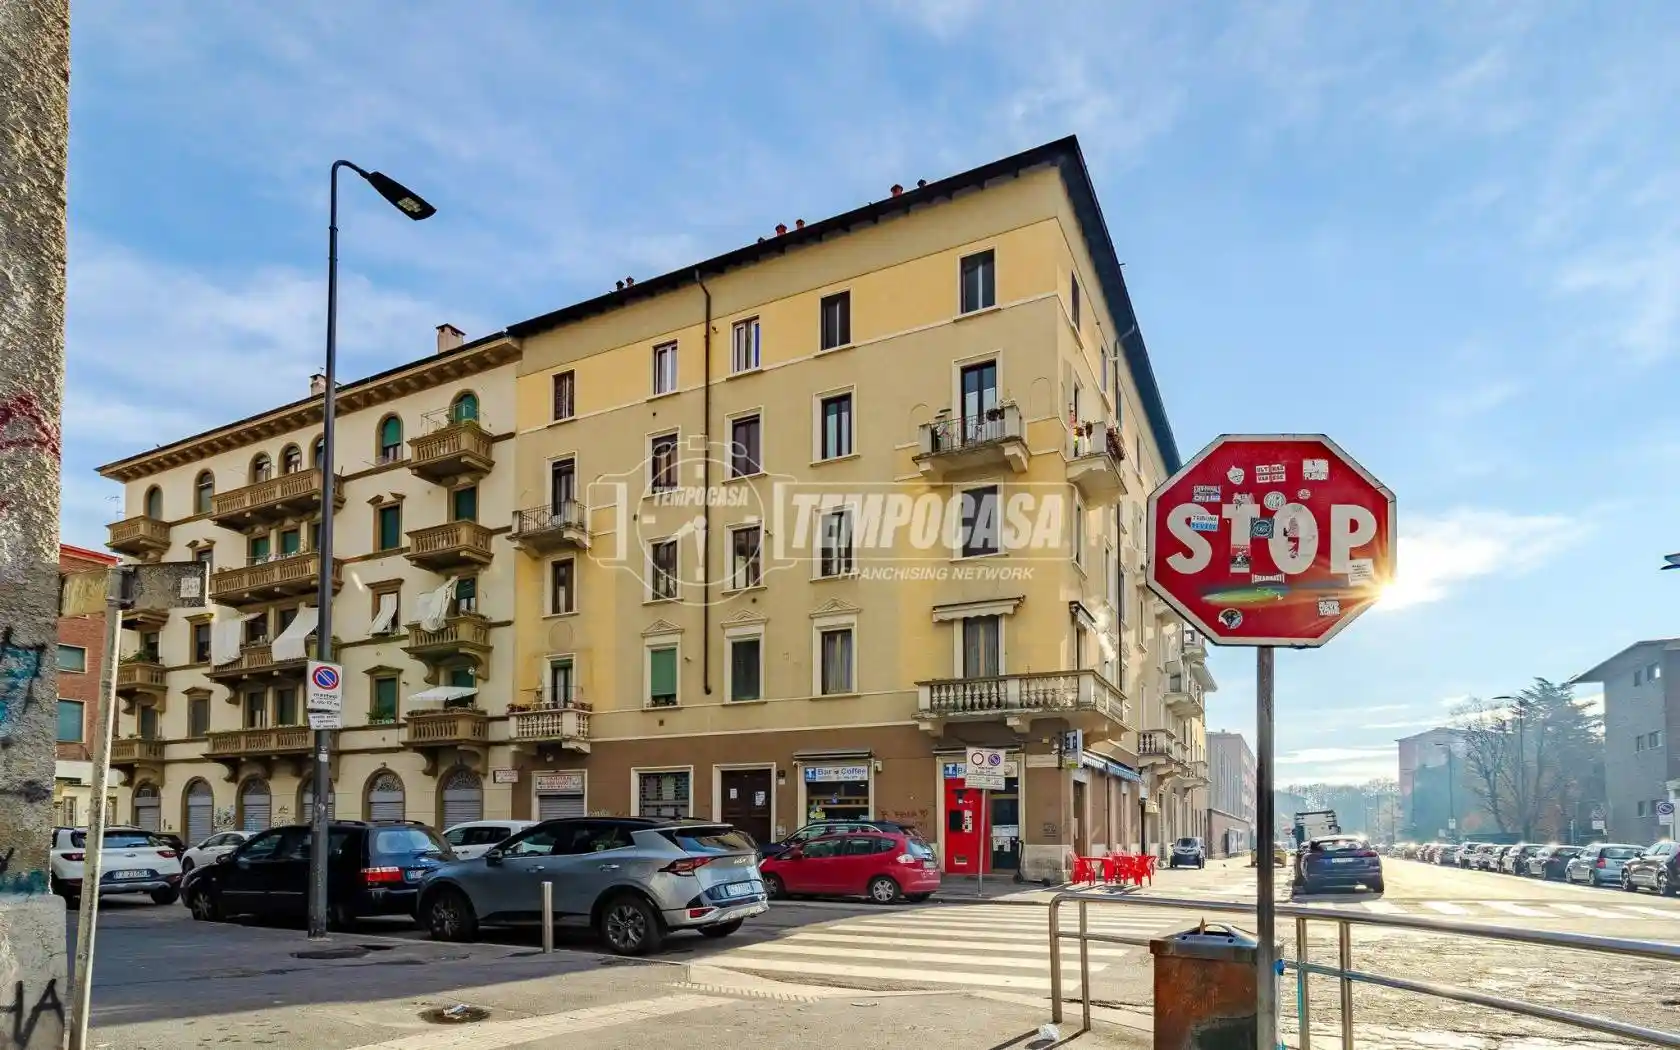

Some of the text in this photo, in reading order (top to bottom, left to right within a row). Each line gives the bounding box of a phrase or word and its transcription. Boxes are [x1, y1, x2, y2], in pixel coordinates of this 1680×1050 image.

[1166, 503, 1378, 575] STOP
[817, 768, 833, 776] Bar
[841, 767, 867, 776] Coffee
